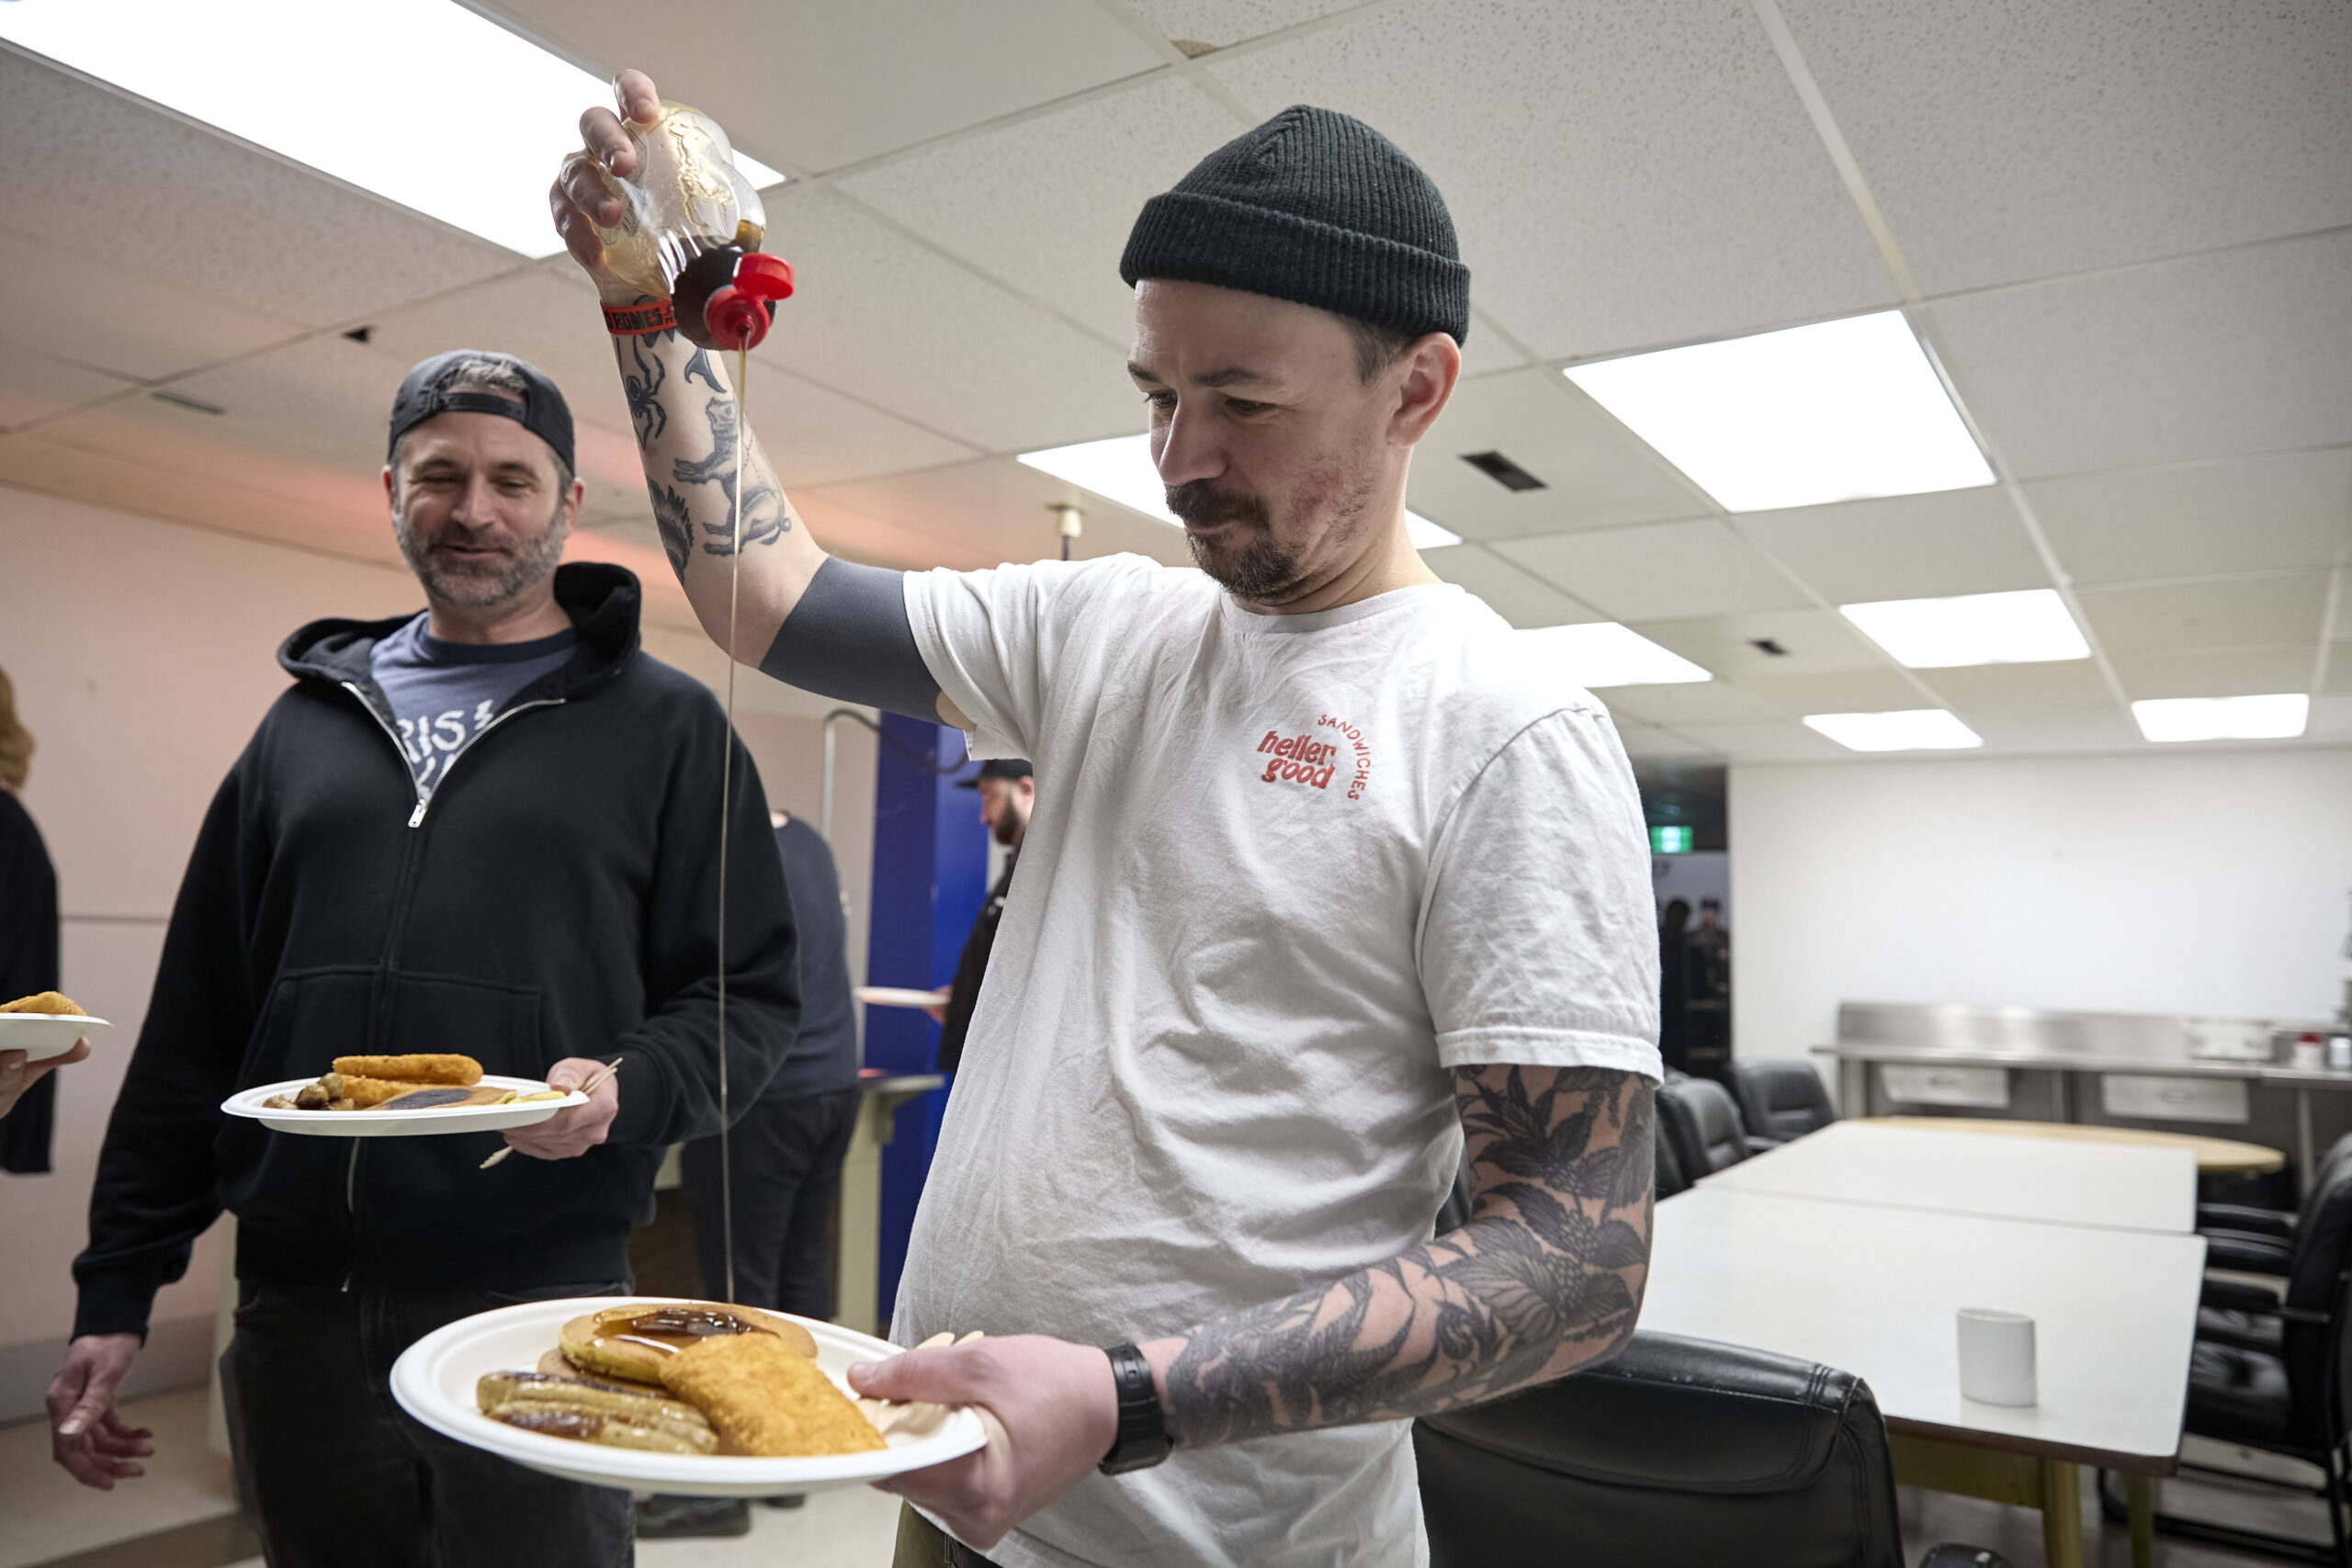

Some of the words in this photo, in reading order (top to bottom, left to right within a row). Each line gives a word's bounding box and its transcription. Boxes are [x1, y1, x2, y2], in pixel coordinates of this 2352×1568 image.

[1257, 730, 1337, 765] heller
[1317, 714, 1371, 800] SANDWICHES
[1261, 758, 1336, 790] good
